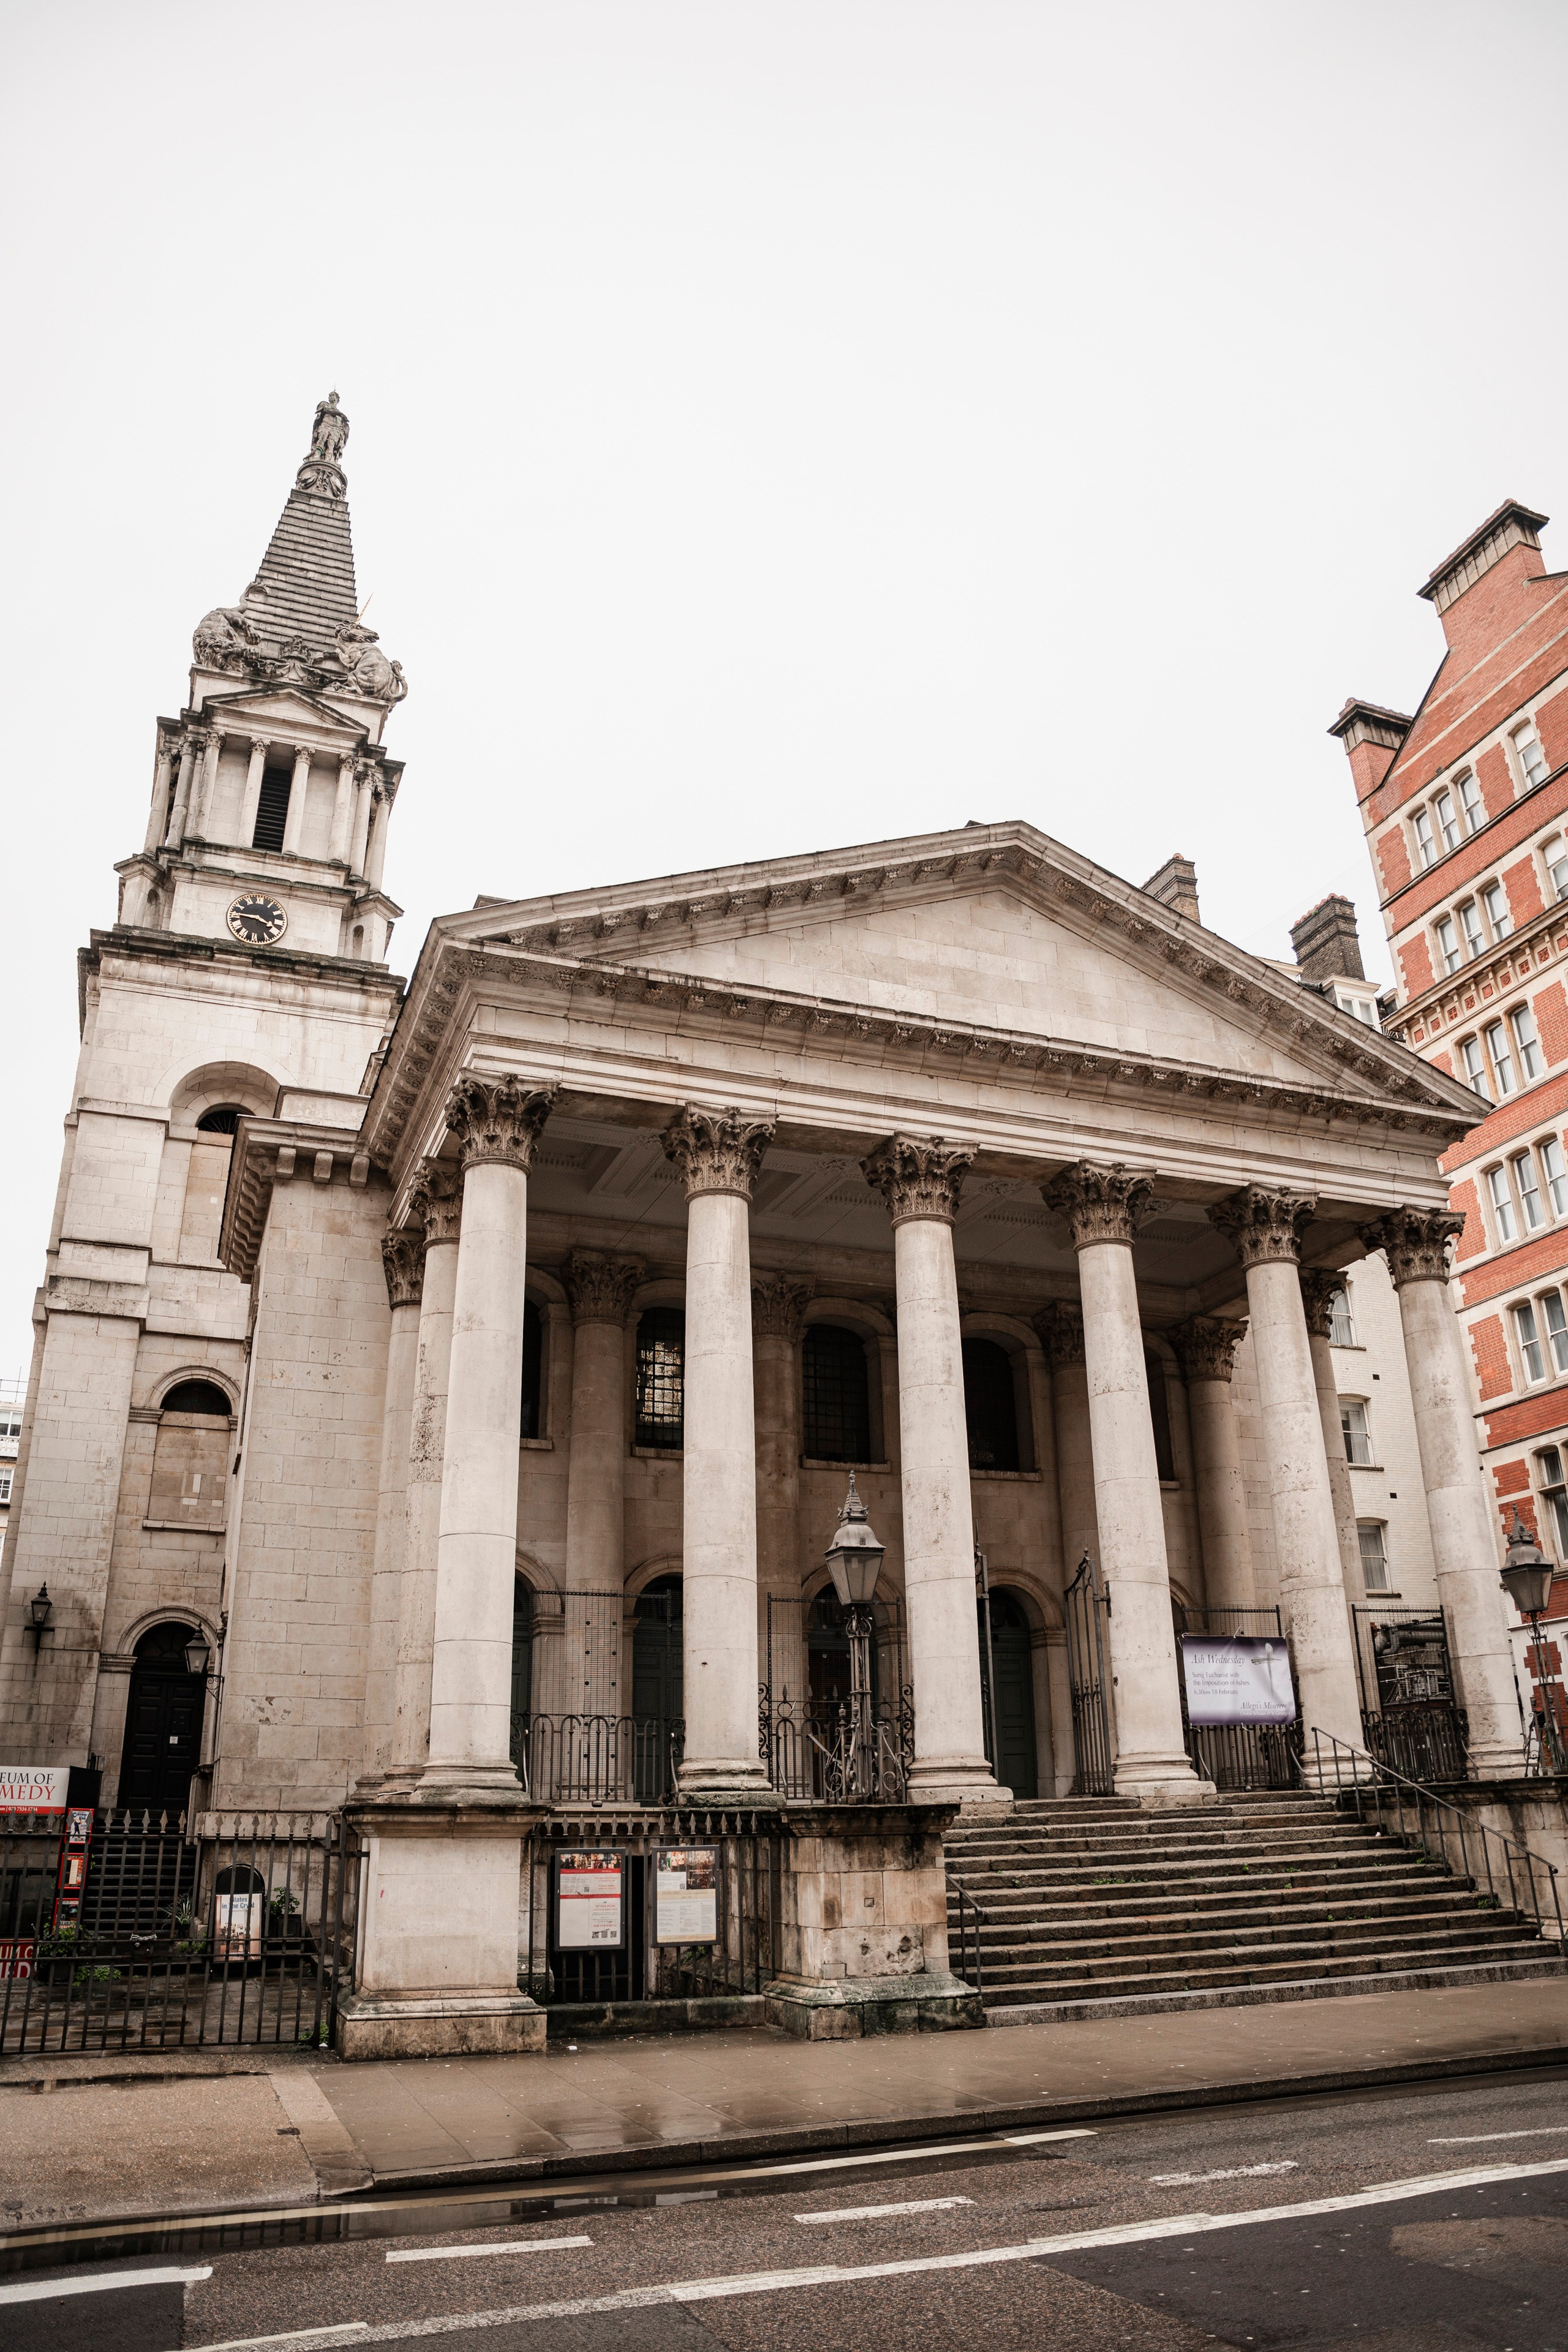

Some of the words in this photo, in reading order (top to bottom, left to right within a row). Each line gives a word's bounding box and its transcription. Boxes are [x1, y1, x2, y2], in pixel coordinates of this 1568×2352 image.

[1191, 1654, 1205, 1664] Ash
[1208, 1654, 1245, 1667] Wednesday
[1240, 1701, 1262, 1711] Allegri's
[0, 1773, 29, 1784] EUM
[34, 1773, 54, 1784] OF
[0, 1784, 56, 1801] MEDY
